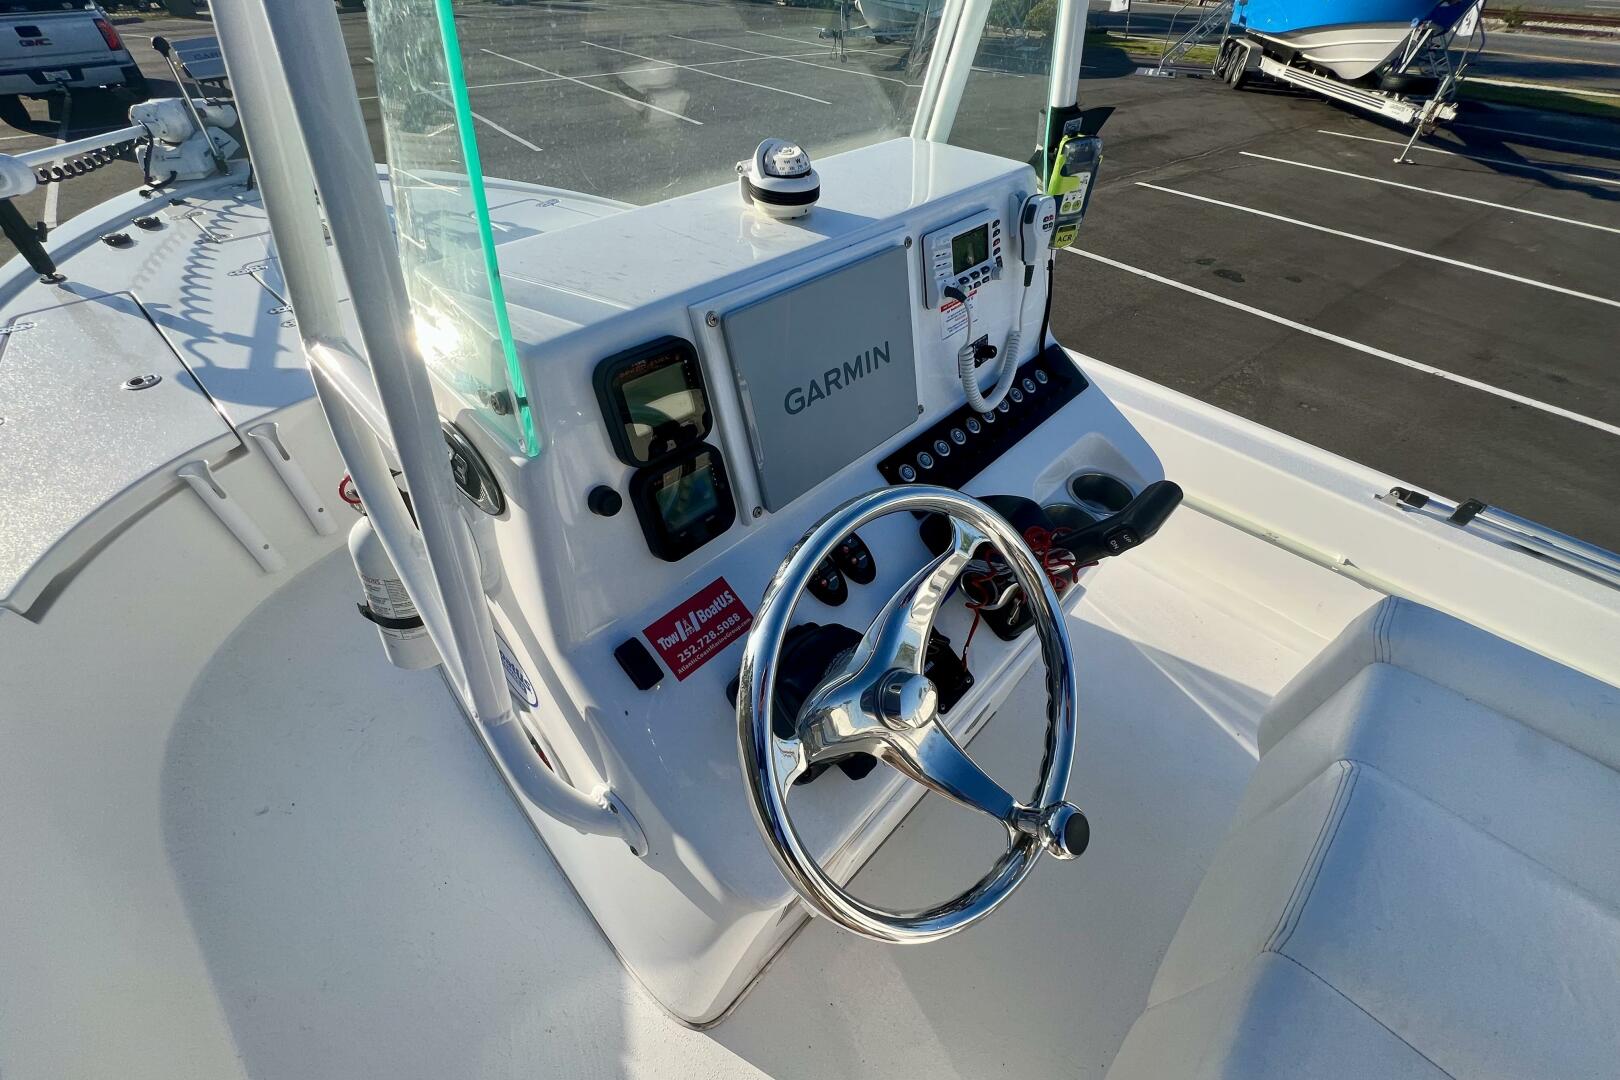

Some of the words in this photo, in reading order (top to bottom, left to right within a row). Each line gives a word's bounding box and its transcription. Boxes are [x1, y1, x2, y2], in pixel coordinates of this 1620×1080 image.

[19, 38, 53, 47] GMC
[1057, 233, 1073, 243] ACR
[784, 341, 890, 415] GARMIN
[677, 612, 741, 663] 252.728.5088
